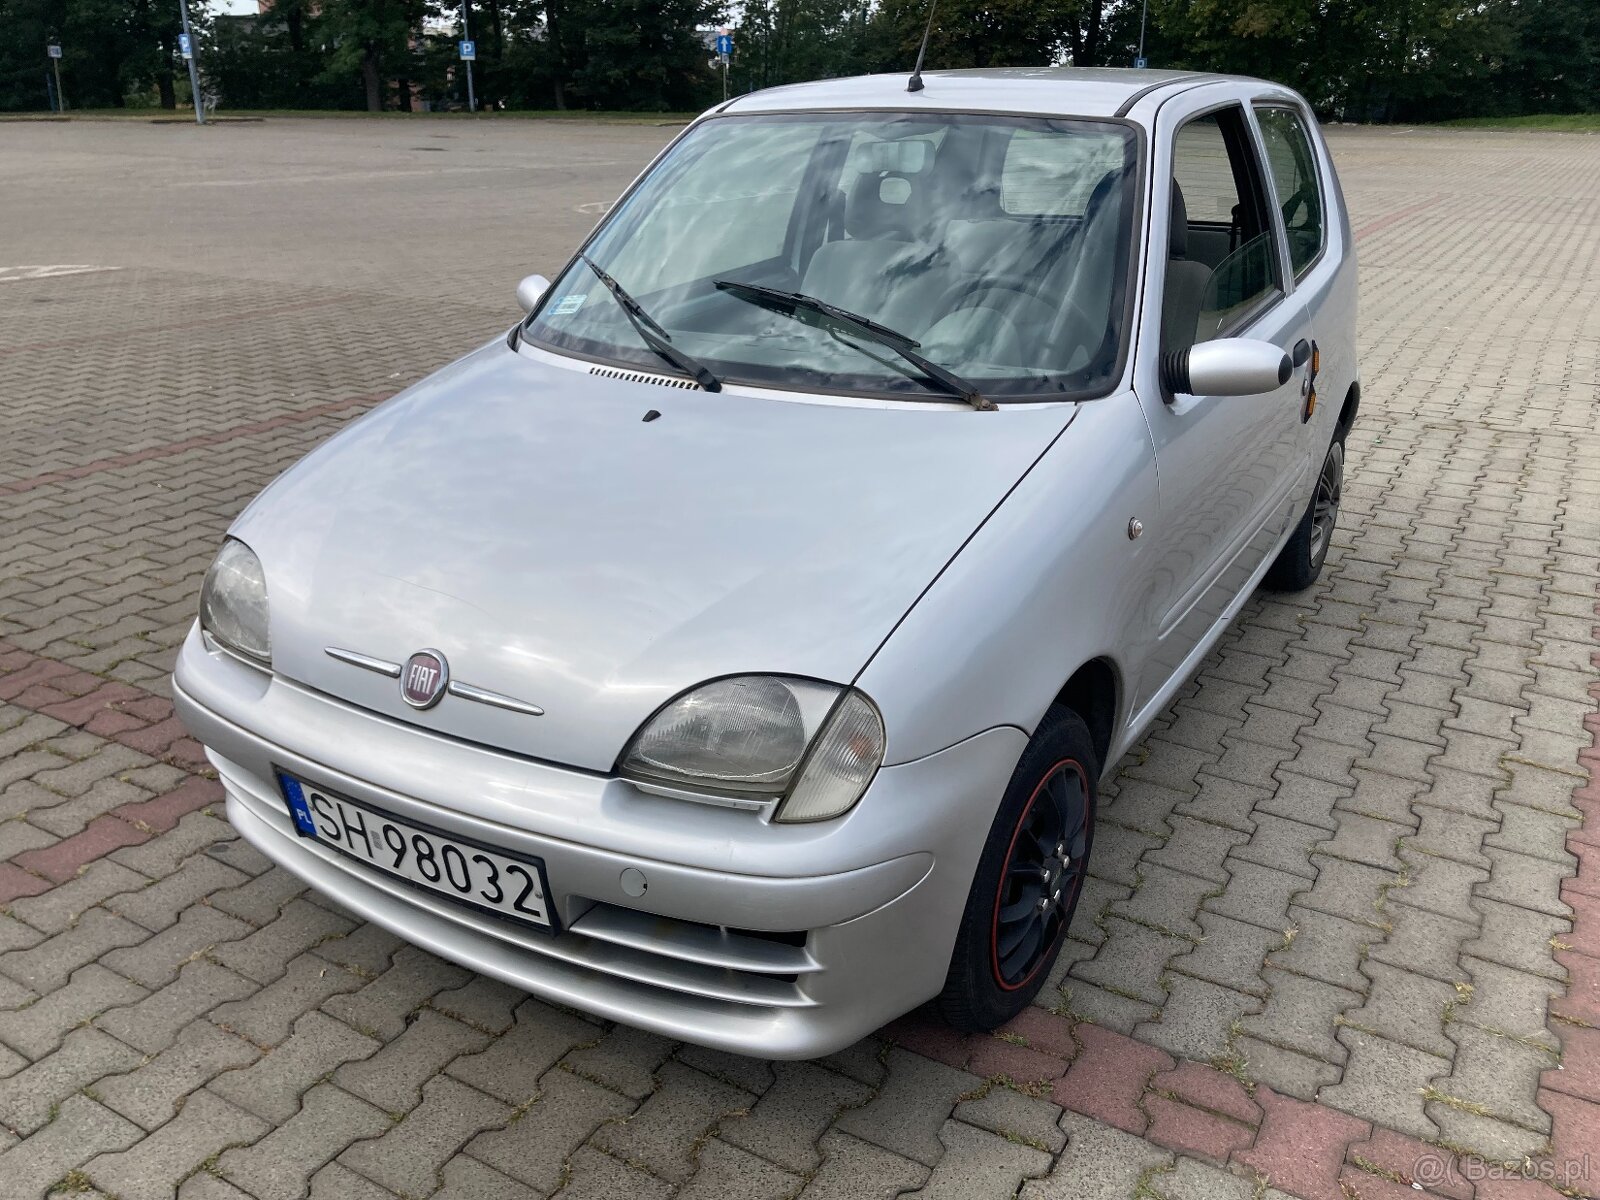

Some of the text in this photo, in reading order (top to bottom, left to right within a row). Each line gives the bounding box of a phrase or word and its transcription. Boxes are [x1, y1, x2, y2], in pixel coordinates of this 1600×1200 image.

[463, 43, 471, 54] P
[408, 664, 437, 694] FIAT
[296, 808, 312, 824] PL
[310, 793, 541, 917] SH 98032
